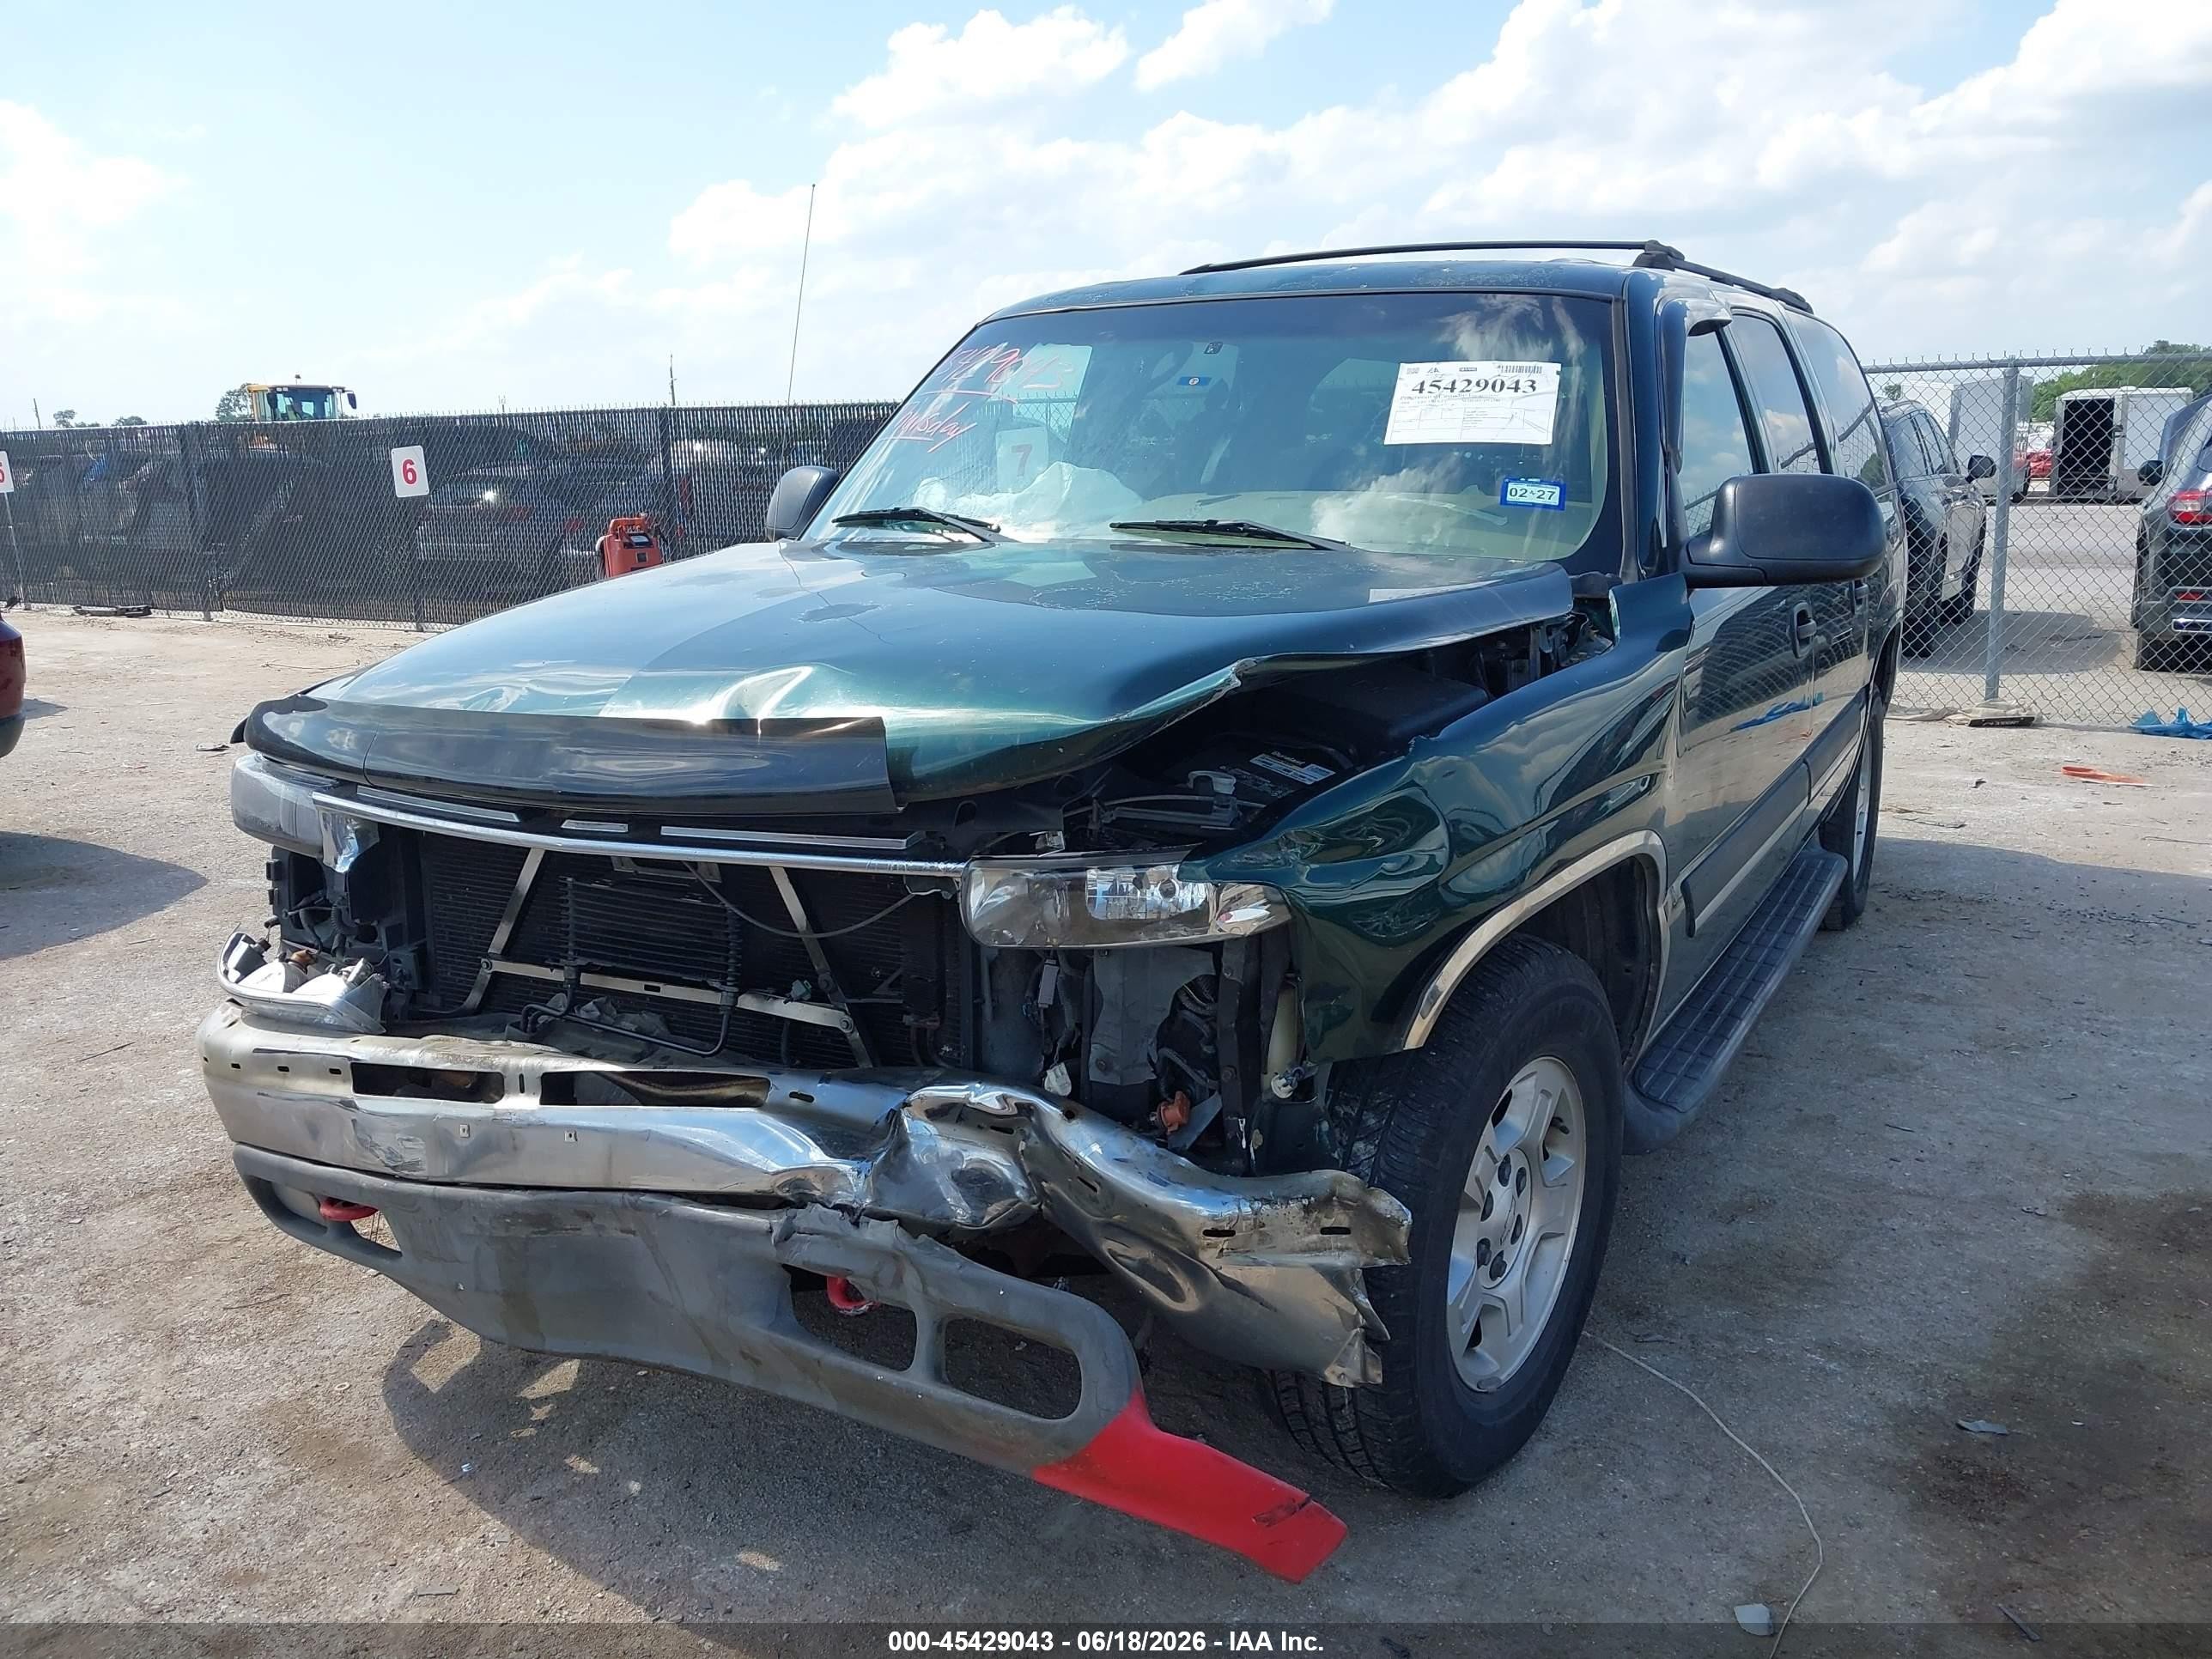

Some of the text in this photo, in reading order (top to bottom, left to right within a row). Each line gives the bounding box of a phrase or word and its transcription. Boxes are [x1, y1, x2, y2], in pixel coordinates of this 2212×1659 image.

[1412, 379, 1537, 394] 45429043
[1011, 443, 1033, 477] 7
[403, 459, 417, 484] 6
[1509, 487, 1528, 498] 02
[1536, 489, 1556, 501] 27
